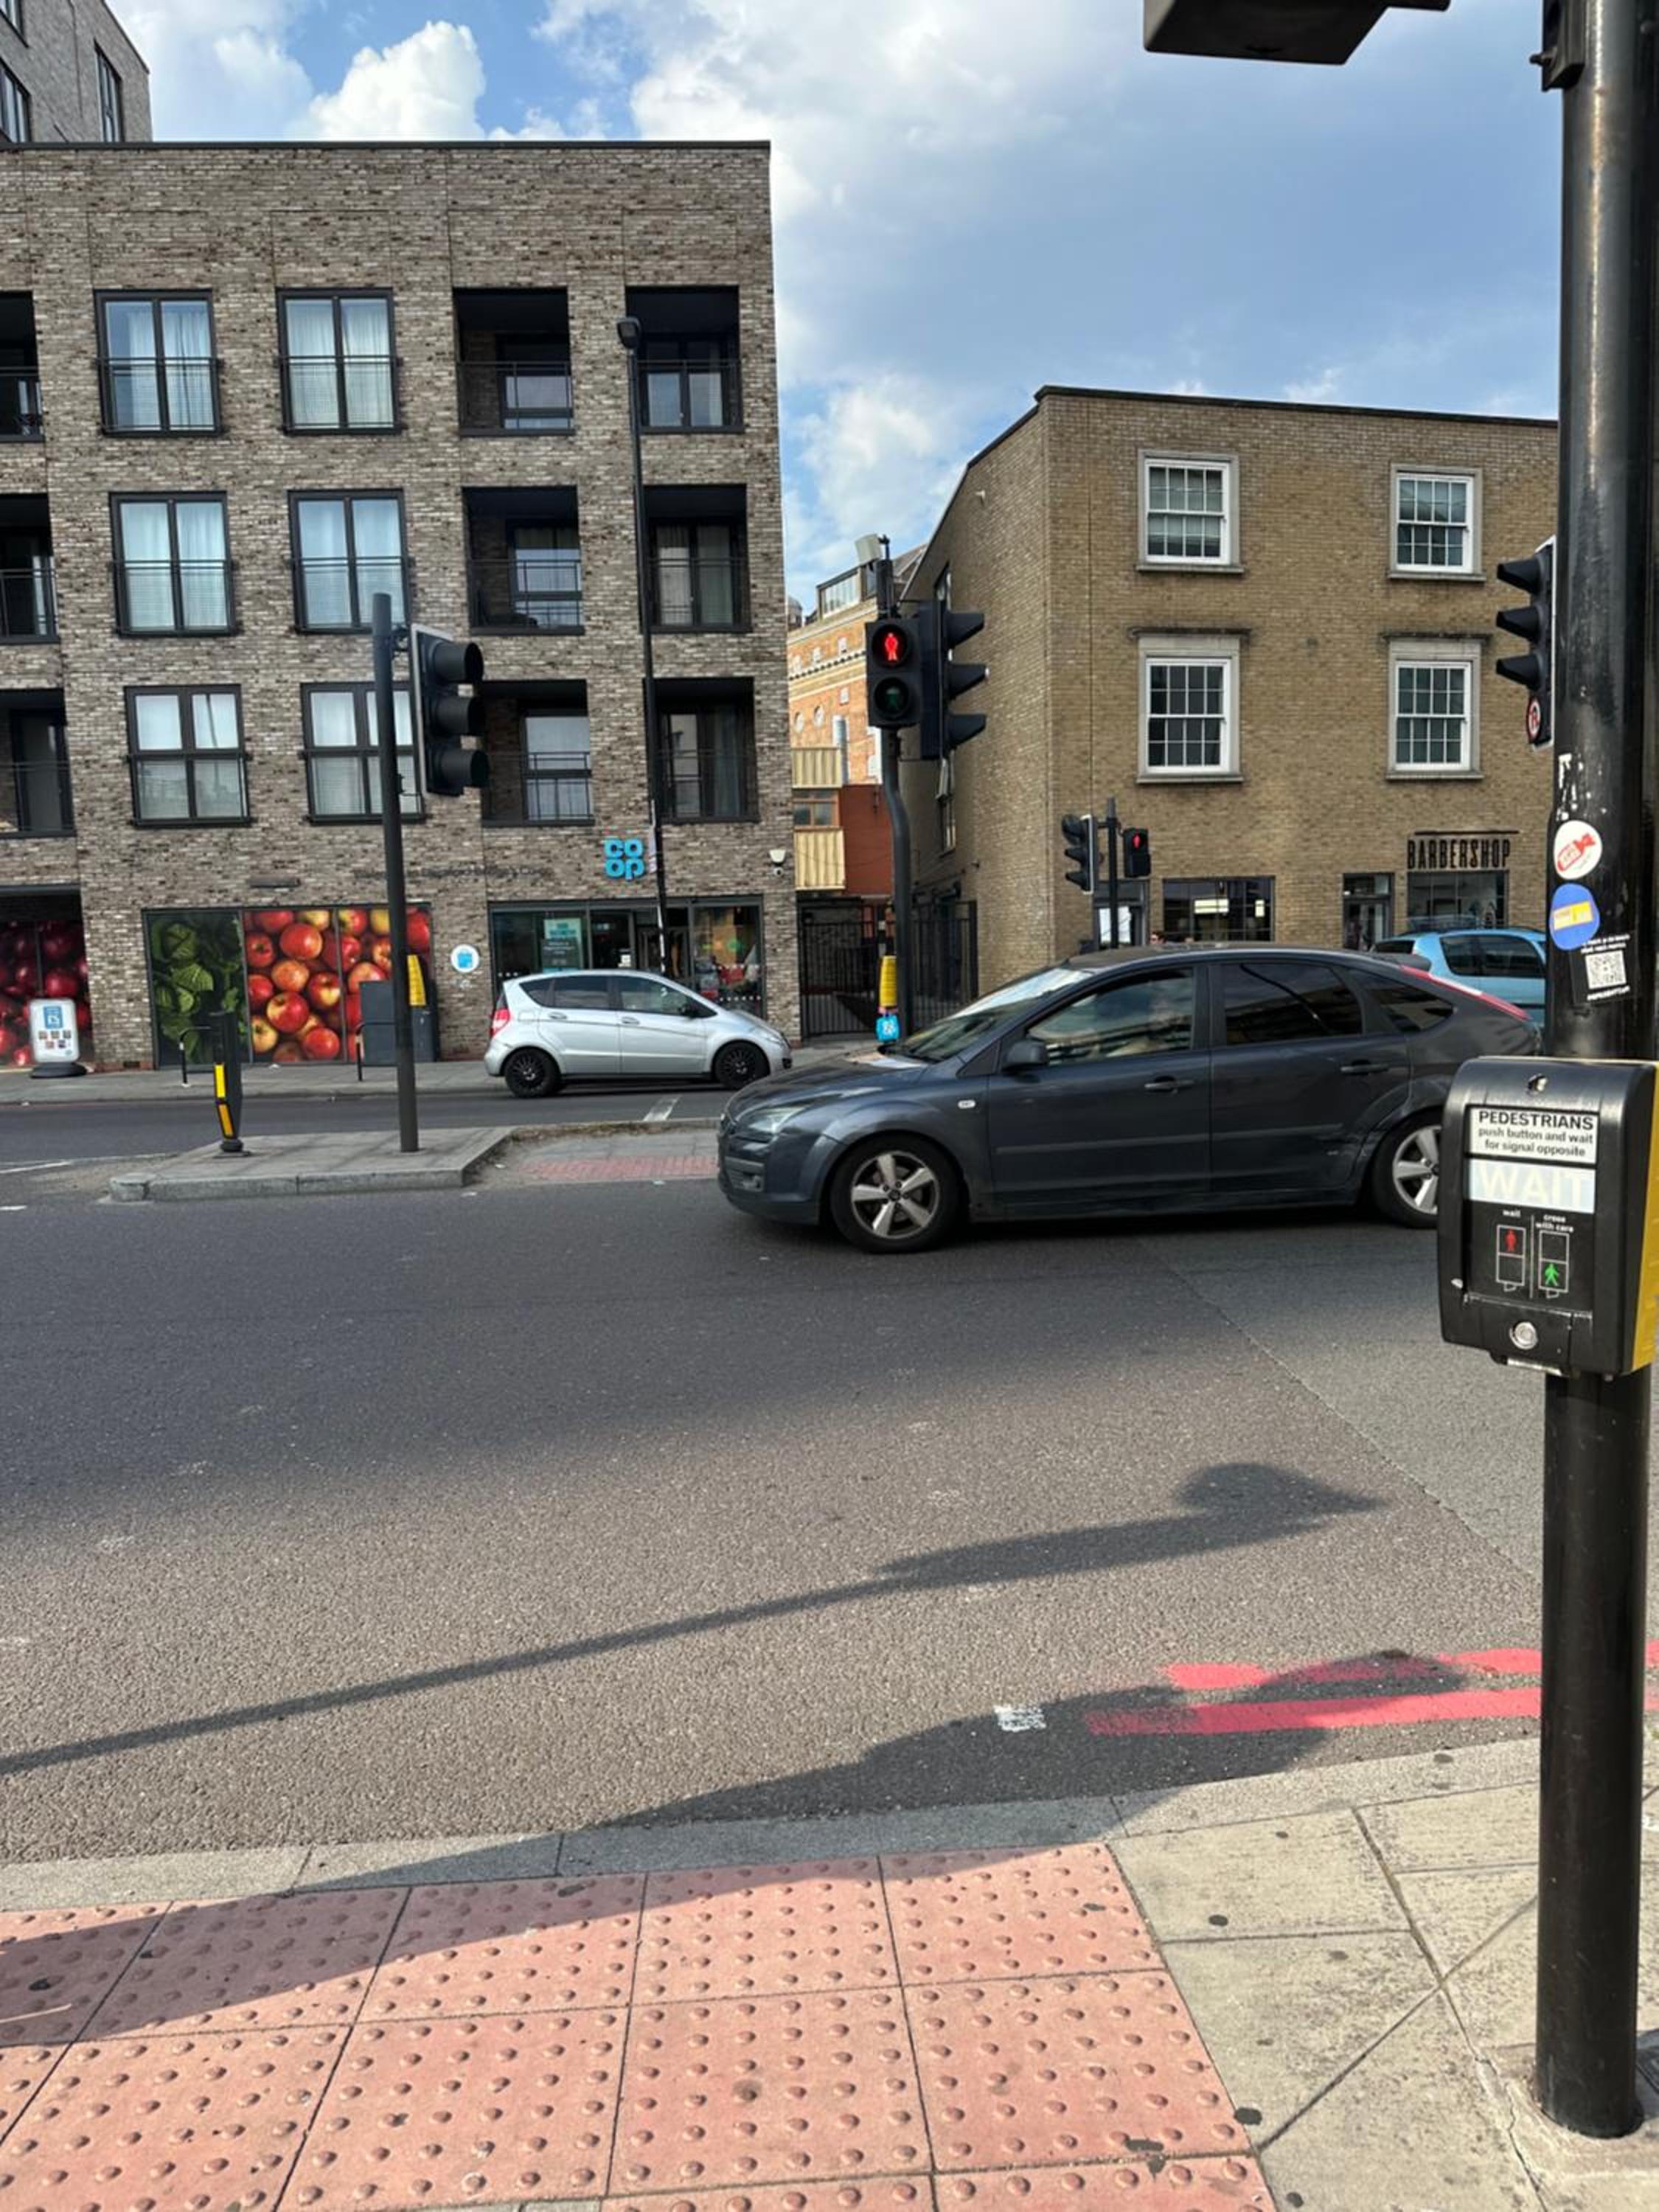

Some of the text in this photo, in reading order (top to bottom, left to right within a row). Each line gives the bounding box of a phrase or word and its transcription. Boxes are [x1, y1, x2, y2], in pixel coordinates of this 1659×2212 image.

[1407, 838, 1511, 869] BARBERSHOP
[1478, 1110, 1594, 1130] PEDESTRIANS
[1478, 1127, 1594, 1144] push button and wait
[1484, 1139, 1586, 1156] for signal opposite
[1478, 1161, 1591, 1208] WAIT
